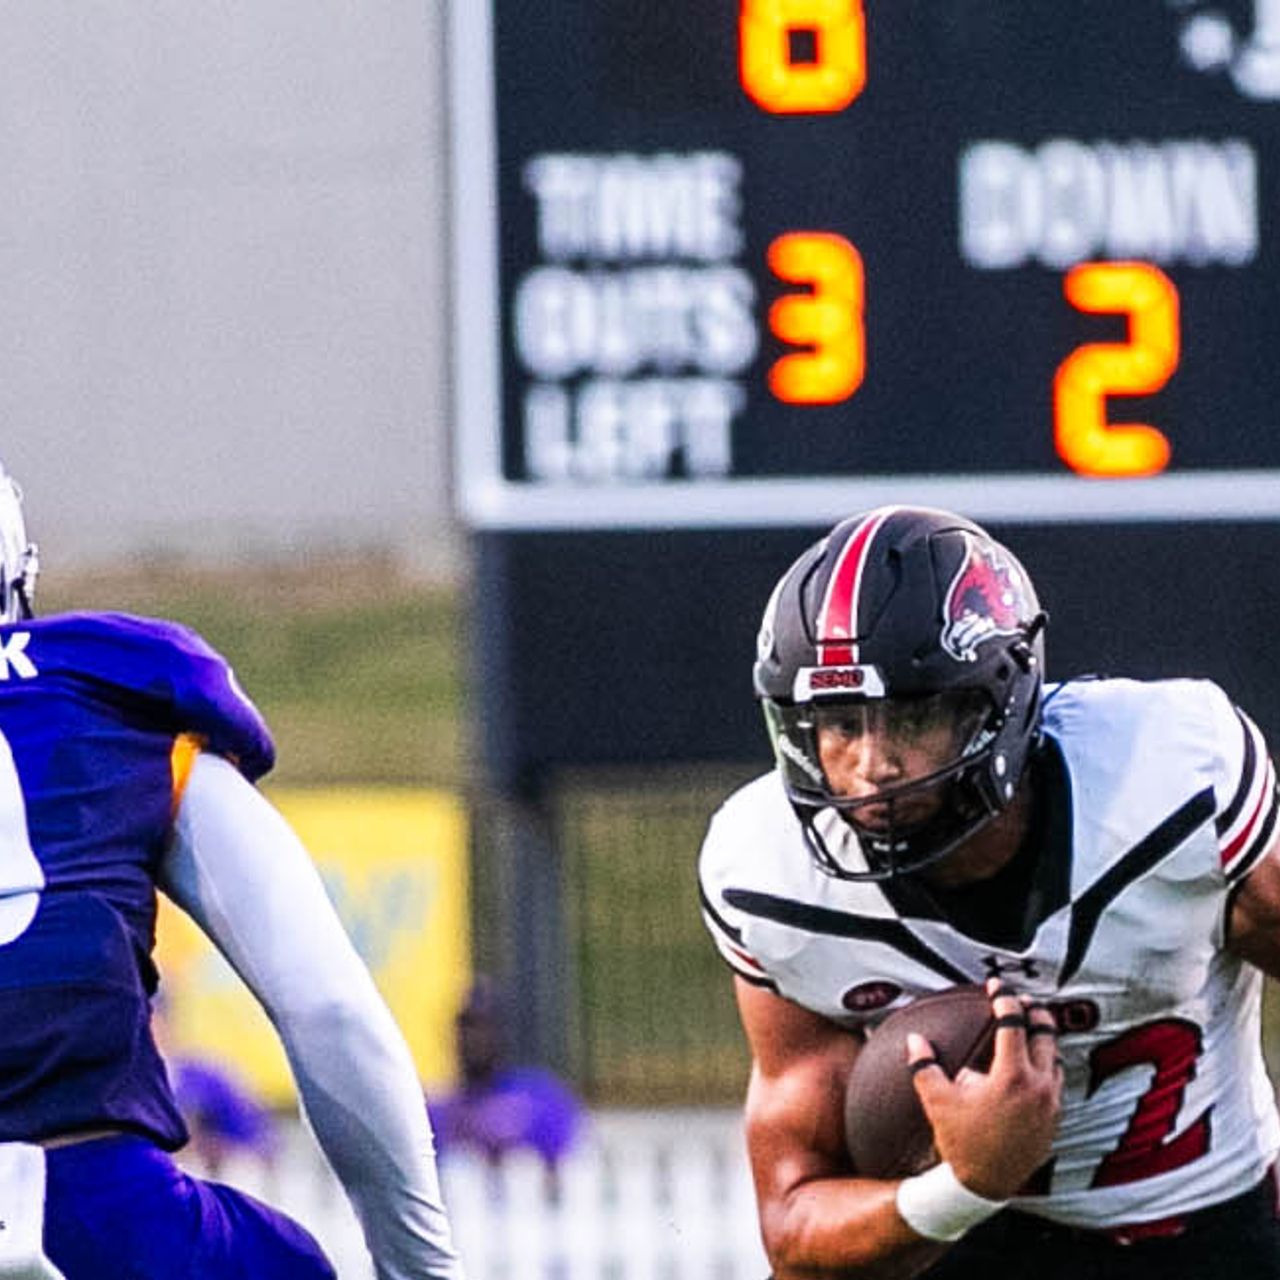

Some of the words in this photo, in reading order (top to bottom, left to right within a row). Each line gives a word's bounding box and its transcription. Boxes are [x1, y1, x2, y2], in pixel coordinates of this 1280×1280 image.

[526, 150, 742, 263] TIME
[958, 138, 1257, 268] DOWN
[516, 263, 757, 378] OUTS
[767, 231, 866, 404] 3
[1053, 260, 1180, 478] 2
[524, 376, 744, 480] LEFT
